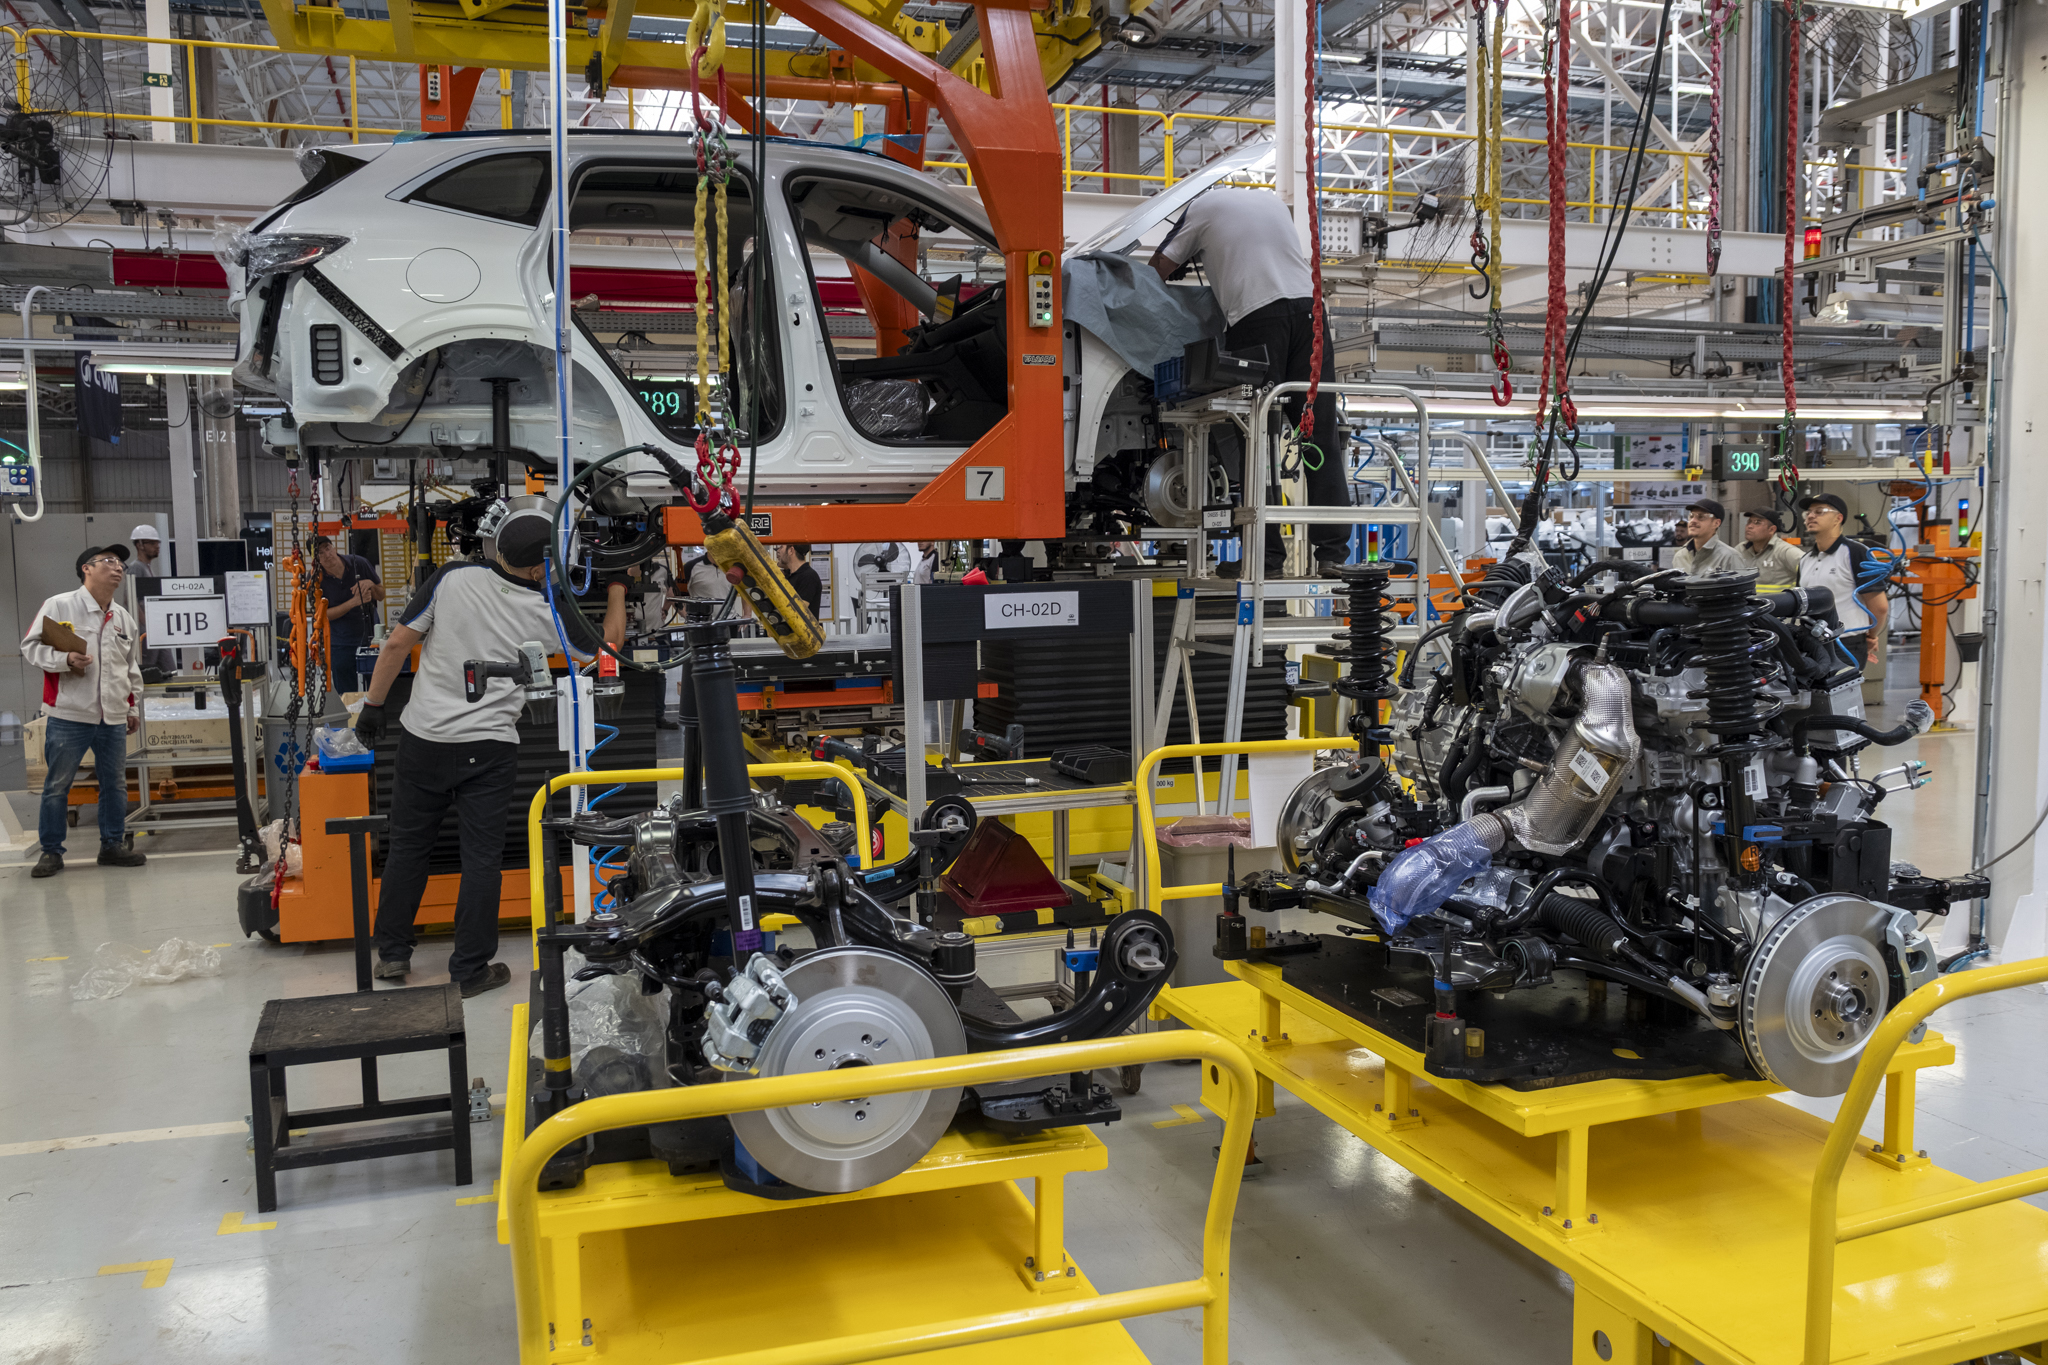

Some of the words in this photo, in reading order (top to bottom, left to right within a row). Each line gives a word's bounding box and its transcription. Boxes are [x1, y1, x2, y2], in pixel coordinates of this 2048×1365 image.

[1731, 452, 1760, 472] 390
[976, 471, 994, 497] 7
[171, 583, 206, 591] CH-02A
[1001, 602, 1062, 617] CH-02D
[1750, 847, 1757, 858] R
